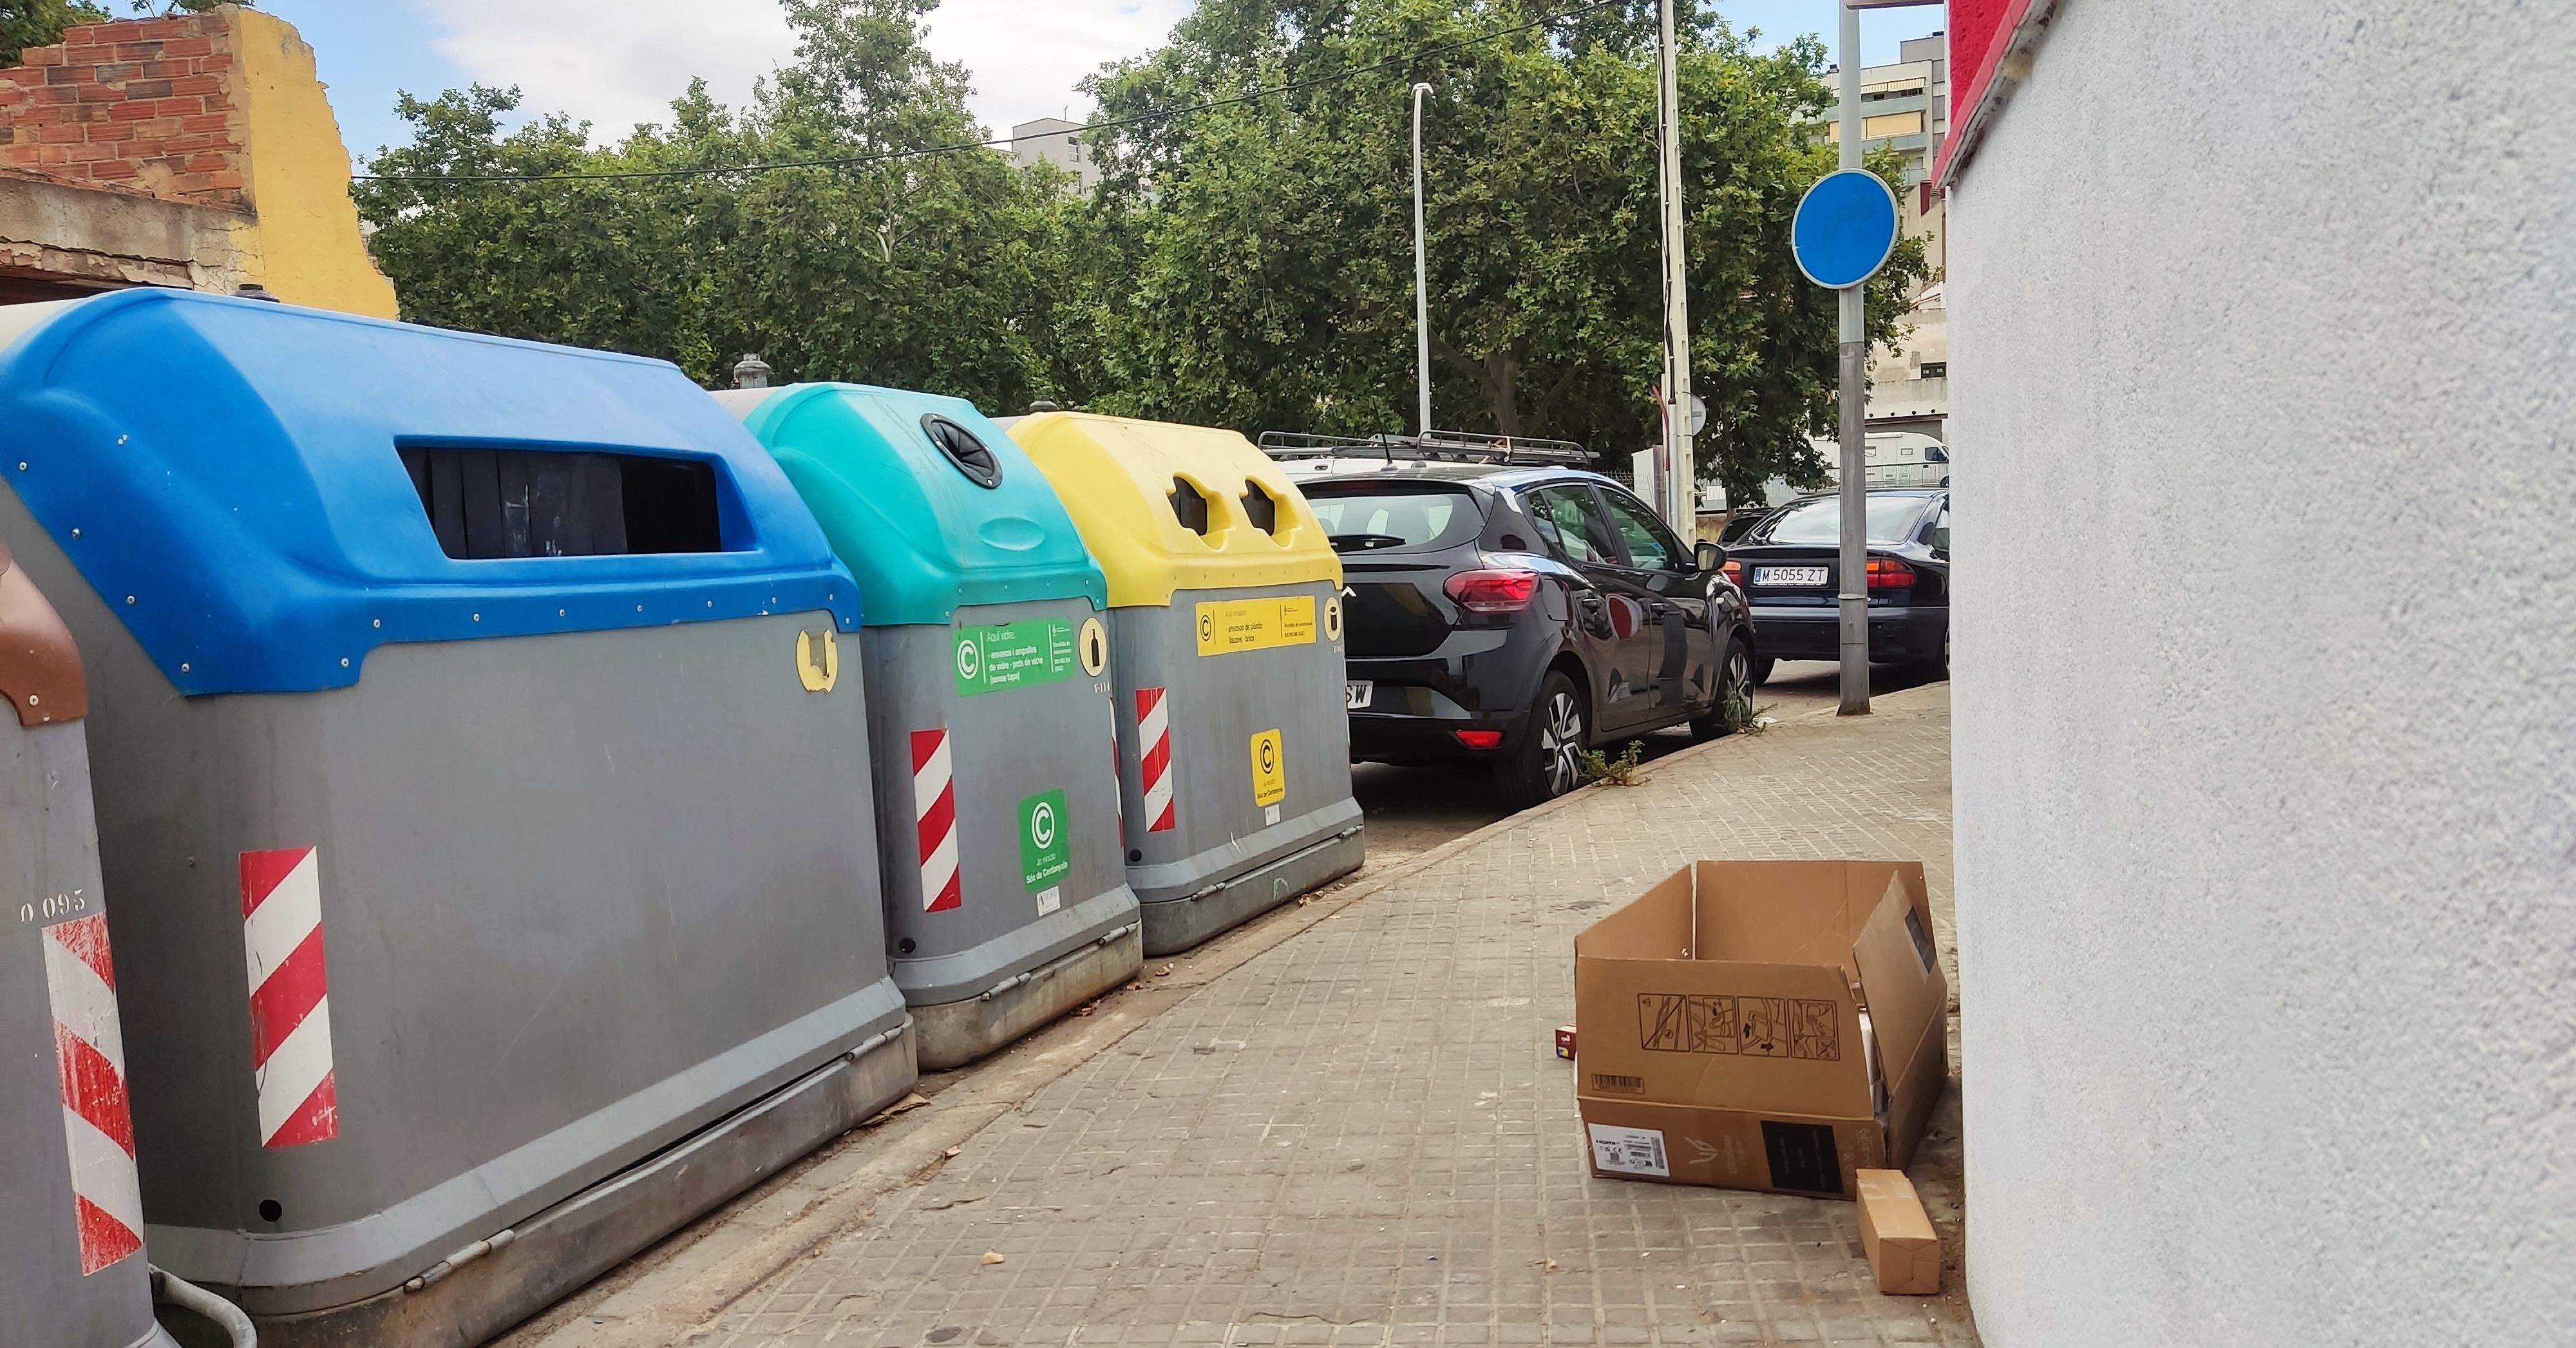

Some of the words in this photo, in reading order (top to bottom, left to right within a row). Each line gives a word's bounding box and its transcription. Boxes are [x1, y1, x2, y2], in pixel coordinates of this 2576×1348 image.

[1763, 570, 1770, 581] M
[1774, 569, 1804, 581] 5055
[1807, 569, 1825, 581] ZT
[43, 888, 86, 919] 095
